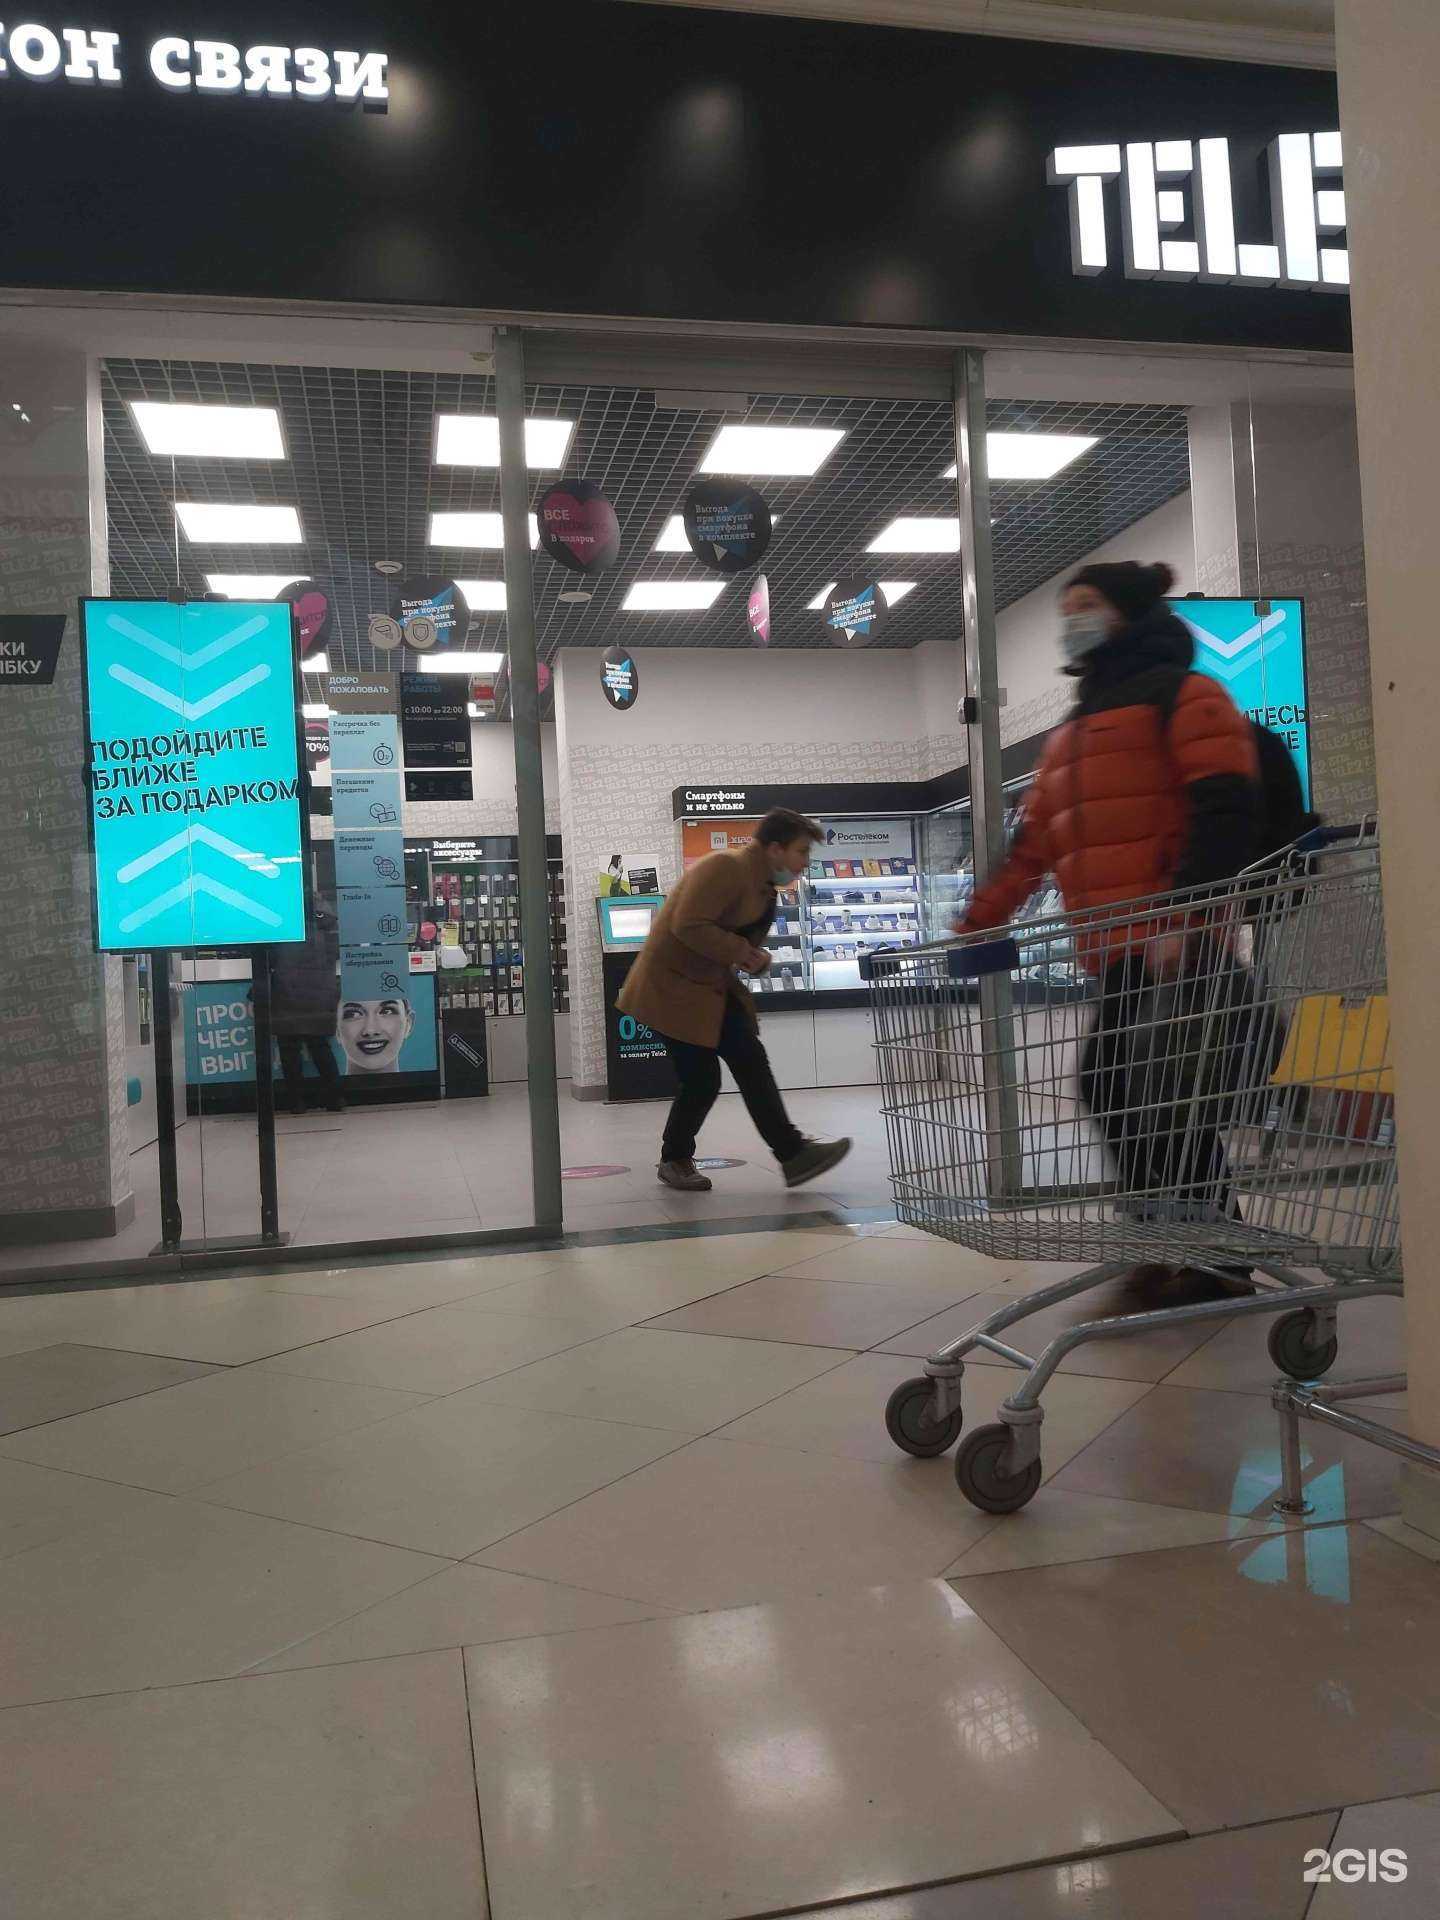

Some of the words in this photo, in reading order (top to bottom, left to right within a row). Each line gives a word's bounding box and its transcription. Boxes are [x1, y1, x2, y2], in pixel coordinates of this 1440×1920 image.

[0, 22, 122, 83] он
[401, 599, 433, 608] Выгода
[402, 609, 420, 618] при
[329, 676, 359, 685] ДОБРО
[329, 686, 389, 694] ПОЖАЛОВАТЬ
[410, 705, 432, 713] 10:00
[442, 705, 463, 714] 22:00
[91, 727, 267, 763] ПОДОЙДИТЕ
[93, 761, 198, 790] БЛИЖЕ
[97, 795, 135, 819] ЗА
[141, 779, 301, 815] ПОДАРКОМ
[685, 790, 746, 803] Смартфоны
[686, 803, 694, 811] и
[695, 803, 708, 811] не
[709, 802, 745, 811] только
[837, 832, 890, 842] Ростелеком
[432, 840, 477, 850] Выберите
[433, 849, 483, 858] аксессуары
[619, 1015, 653, 1040] 0%
